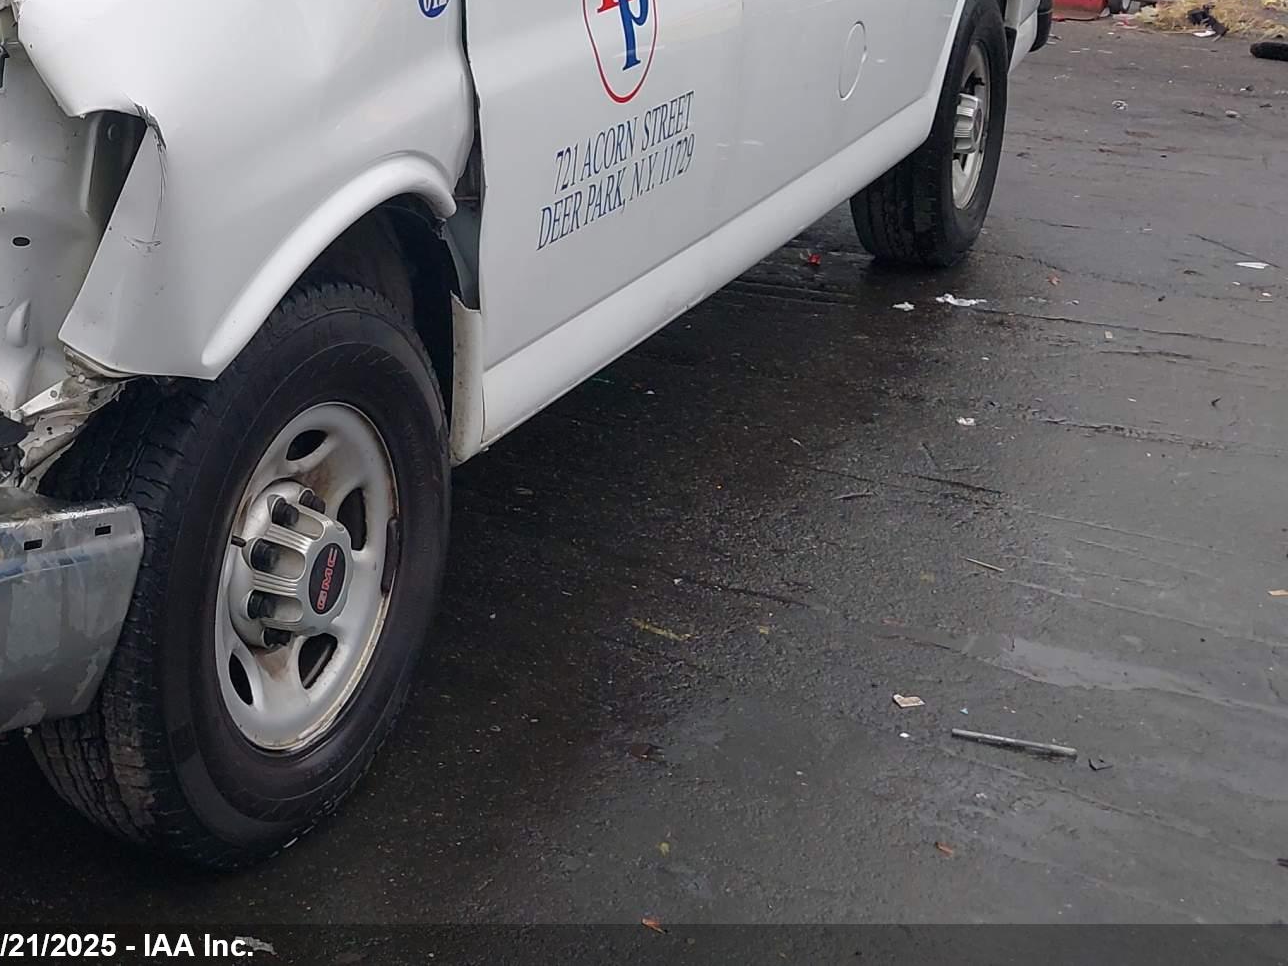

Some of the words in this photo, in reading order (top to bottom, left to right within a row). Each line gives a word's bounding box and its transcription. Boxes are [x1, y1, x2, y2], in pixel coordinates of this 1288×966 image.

[536, 190, 583, 251] DEER
[659, 133, 696, 186] 11729
[554, 144, 579, 194] 721
[580, 117, 638, 182] ACORN
[641, 90, 695, 153] STREET
[317, 547, 338, 610] GMC
